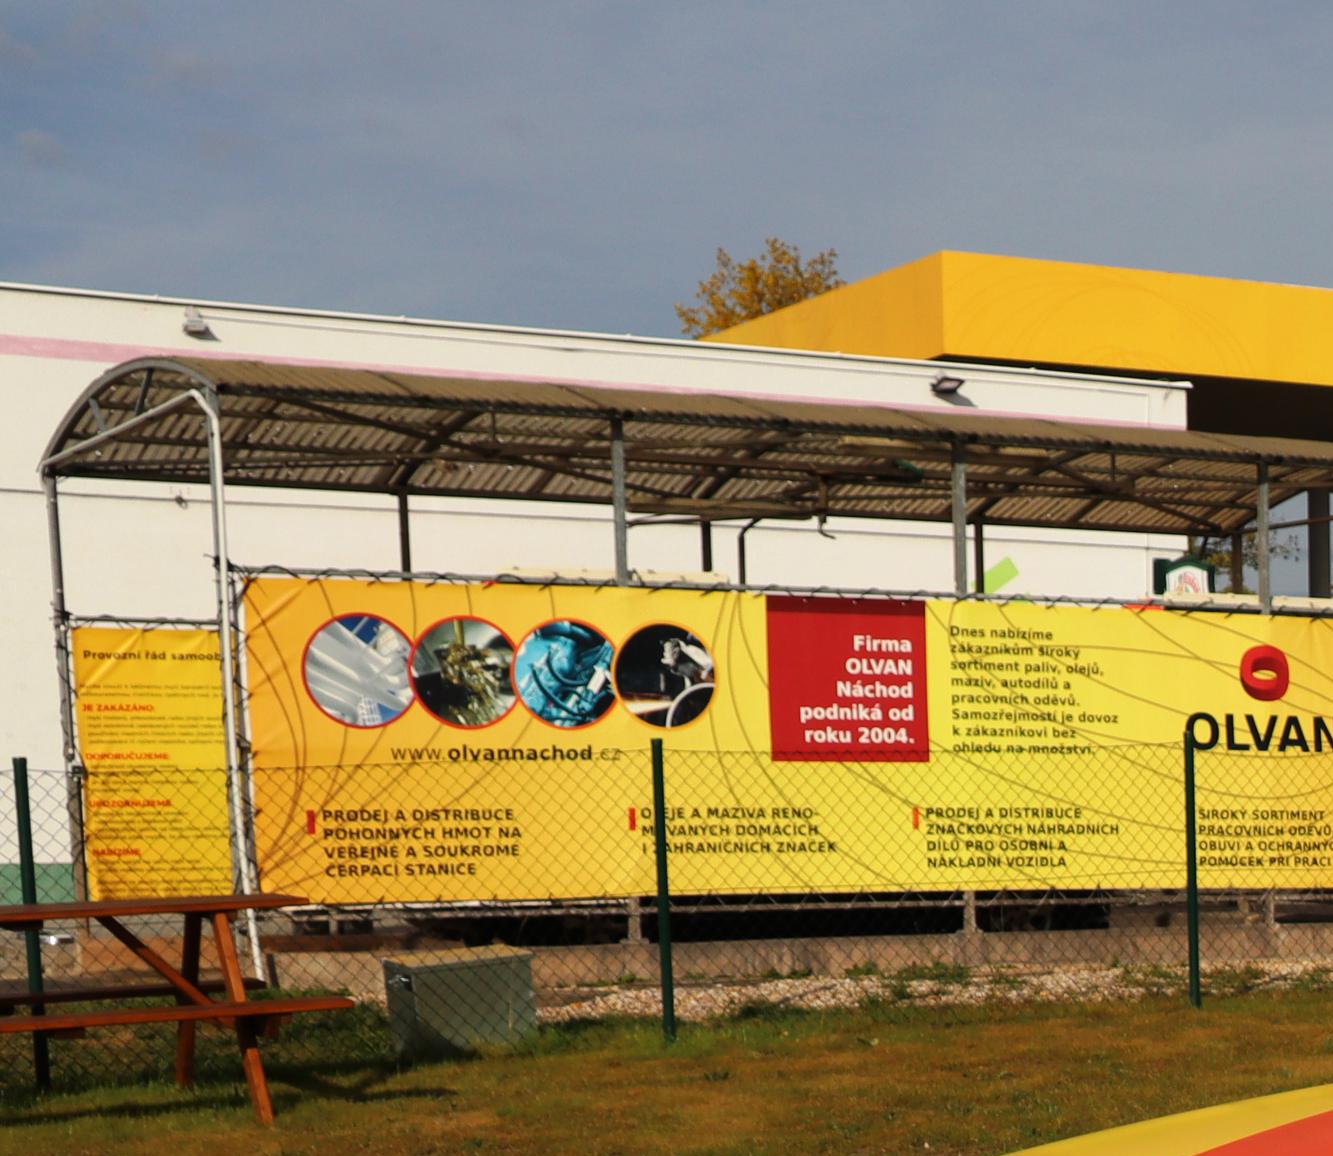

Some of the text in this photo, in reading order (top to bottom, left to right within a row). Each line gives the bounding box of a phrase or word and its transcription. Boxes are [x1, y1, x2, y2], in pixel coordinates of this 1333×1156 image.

[950, 625, 1053, 640] Dnes nabízíme
[853, 634, 912, 652] Firma
[83, 650, 141, 660] Provozní
[950, 643, 1080, 660] zákazníkům široký
[845, 657, 912, 675] OLVAN
[951, 659, 1104, 677] sortiment paliv, olejů,
[836, 680, 913, 698] Náchod
[951, 677, 1071, 690] maziv, autodílů a
[951, 693, 1080, 707] pracovních oděvů.
[82, 704, 93, 712] JE
[800, 703, 914, 724] podniká od
[952, 708, 1119, 726] Samozřejmostí je dovoz
[804, 726, 915, 744] roku 2004.
[952, 725, 1077, 738] k zákazníkovi bez
[390, 744, 621, 762] www.olvannachod.cz
[953, 741, 1095, 755] ohledu na množství.
[322, 808, 514, 824] PRODEJ A DISTRIBUCE
[641, 807, 819, 821] OEJE A MAZIVA RENO-
[926, 807, 1081, 820] PRODEJ A DISTRIBUCE
[1252, 809, 1326, 821] SORTIMENT
[324, 825, 522, 840] POHONNÝCH HMOT NA
[642, 823, 730, 836] MVANÝCH
[1198, 823, 1284, 836] PRACOVNÍCH
[405, 846, 417, 858] A
[966, 840, 994, 851] PRO
[1057, 840, 1067, 851] A
[1199, 840, 1240, 851] OBUVI
[1245, 841, 1253, 851] A
[404, 862, 477, 876] STANICE
[1005, 856, 1066, 868] VOZIDLA
